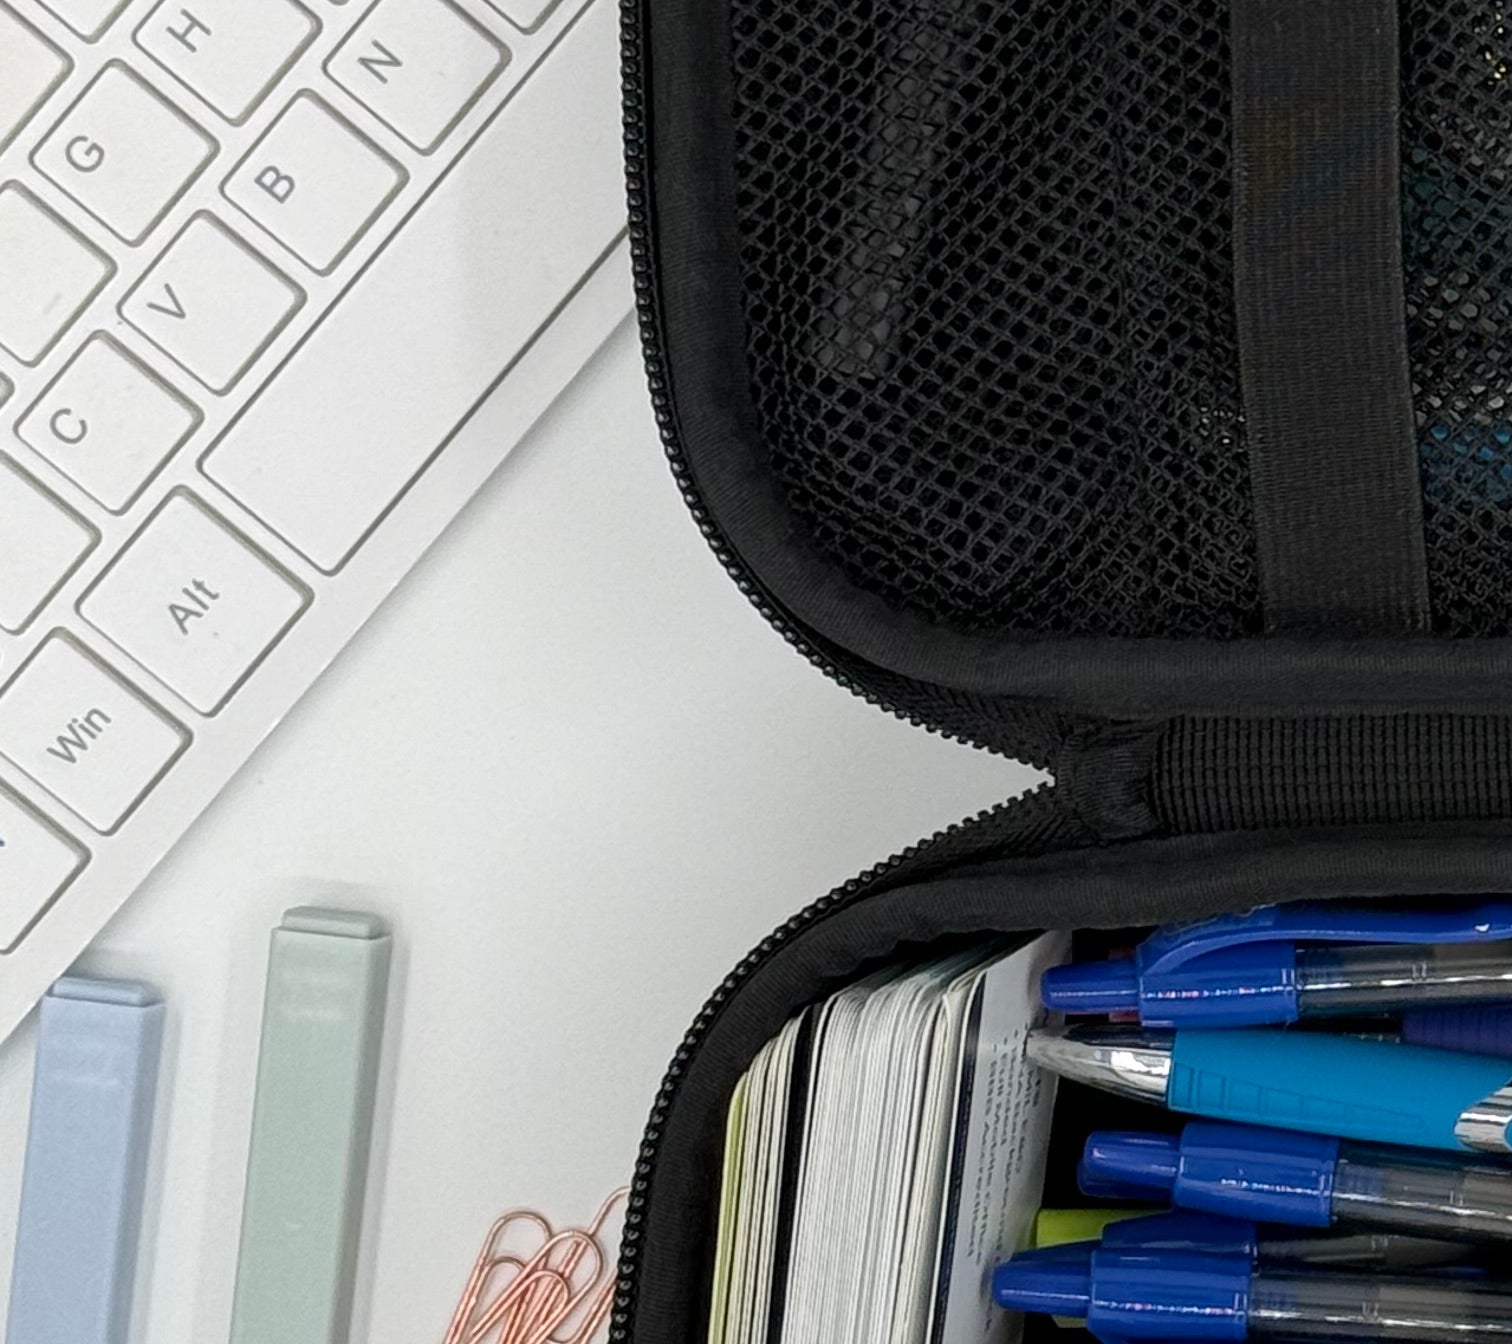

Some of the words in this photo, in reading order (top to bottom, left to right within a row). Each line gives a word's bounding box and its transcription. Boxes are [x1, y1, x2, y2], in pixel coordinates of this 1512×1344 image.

[166, 9, 211, 52] H
[358, 40, 402, 84] N
[65, 136, 104, 172] G
[254, 166, 295, 203] B
[147, 284, 186, 319] V
[50, 408, 87, 444] C
[169, 579, 219, 635] Alt
[47, 709, 111, 763] Win
